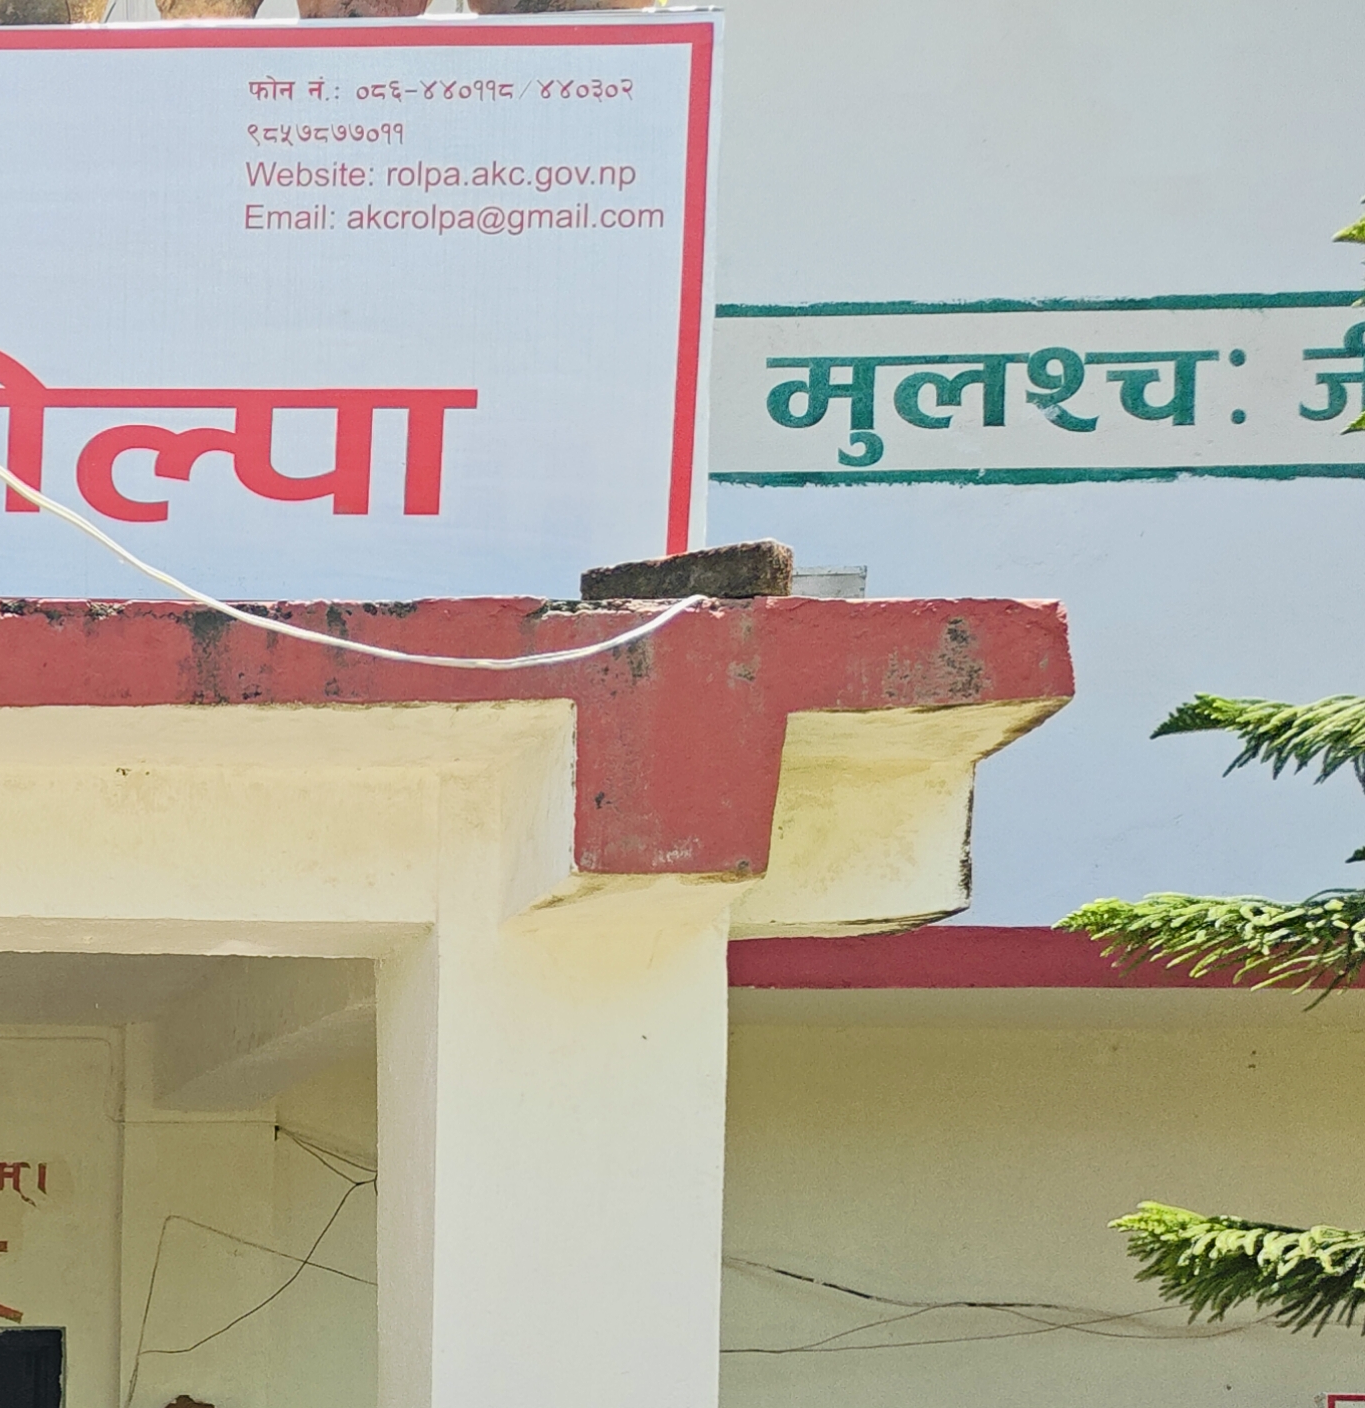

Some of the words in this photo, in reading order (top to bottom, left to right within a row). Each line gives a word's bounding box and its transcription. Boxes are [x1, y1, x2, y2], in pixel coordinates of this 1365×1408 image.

[248, 76, 295, 101] फोन
[245, 162, 375, 188] Website:
[385, 162, 637, 192] rolpa.akc.gov.np
[244, 204, 336, 231] Email:
[347, 204, 665, 236] akcrolpa@gmail.com
